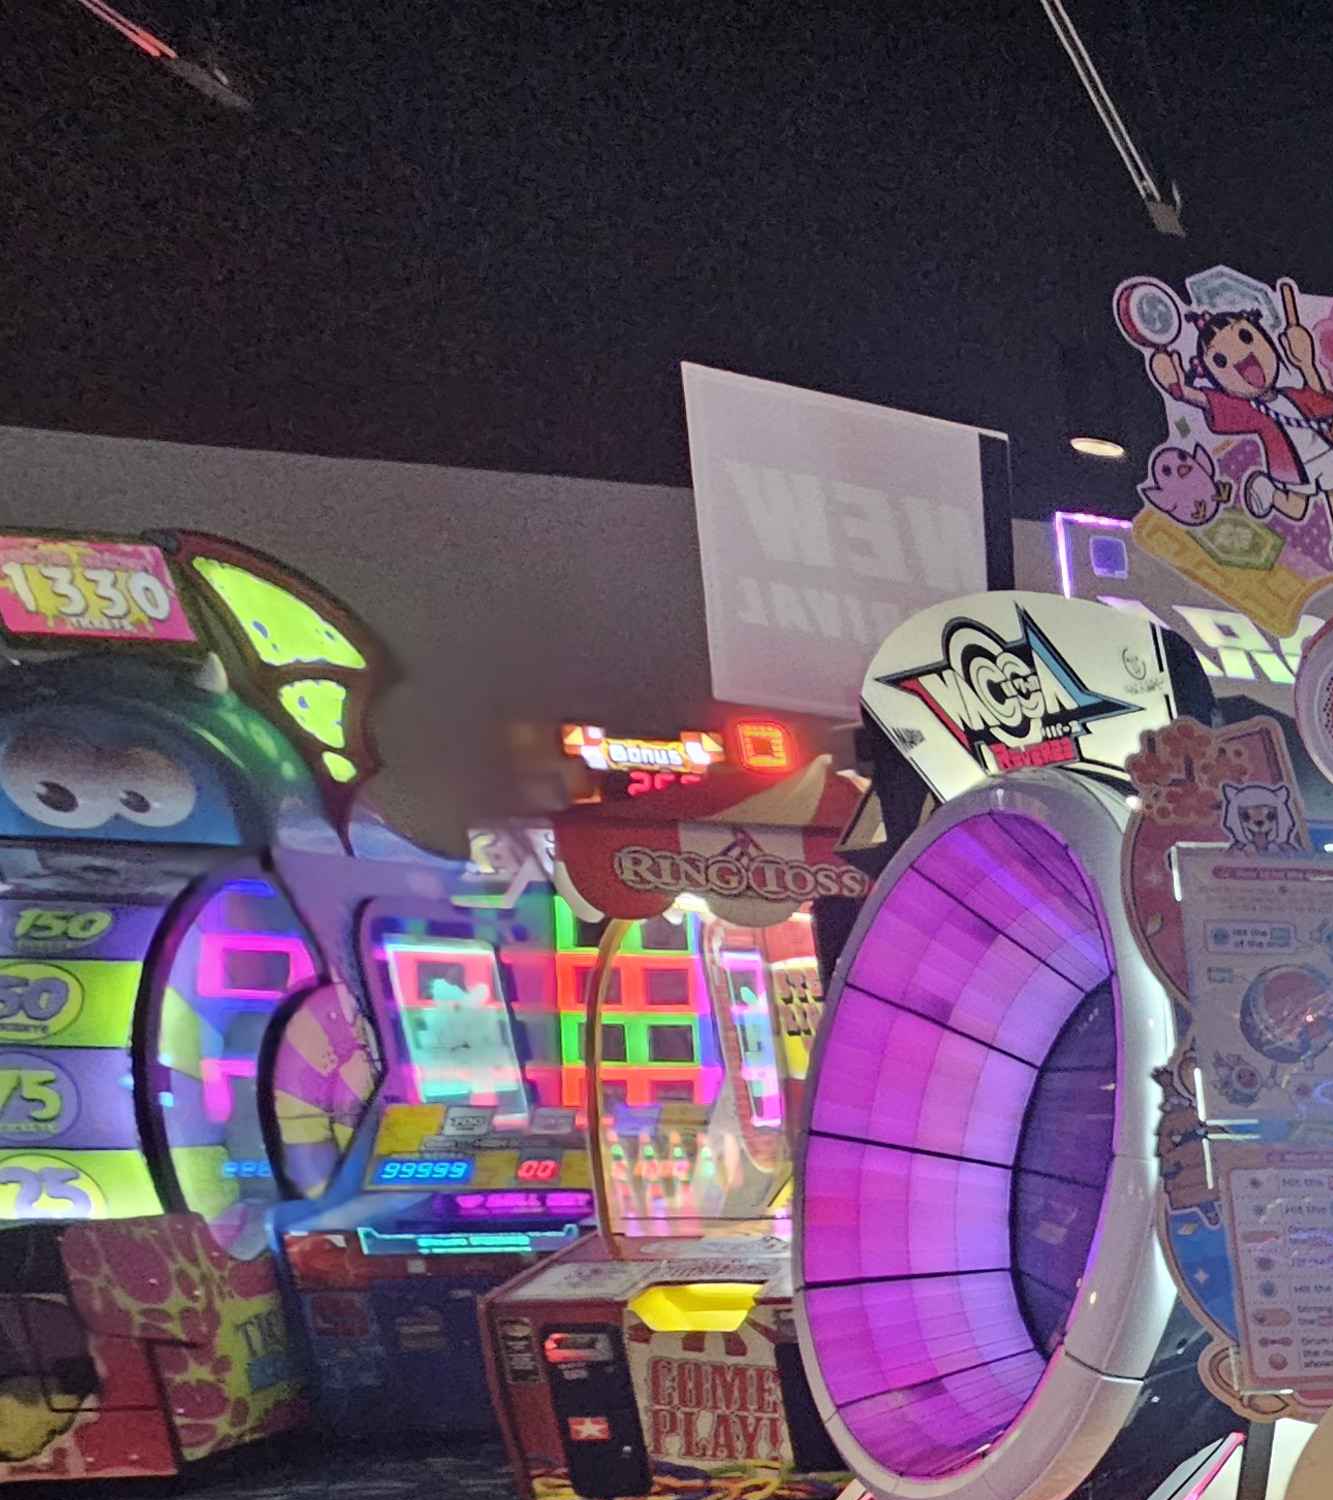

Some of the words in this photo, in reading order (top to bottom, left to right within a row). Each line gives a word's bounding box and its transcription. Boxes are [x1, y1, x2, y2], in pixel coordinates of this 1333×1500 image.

[1, 561, 171, 622] 1330
[616, 848, 746, 895] RING
[752, 856, 867, 899] TOSS
[14, 908, 113, 941] 150
[381, 1161, 469, 1179] 99999
[650, 1357, 781, 1415] COME
[650, 1407, 786, 1462] PLAY!
